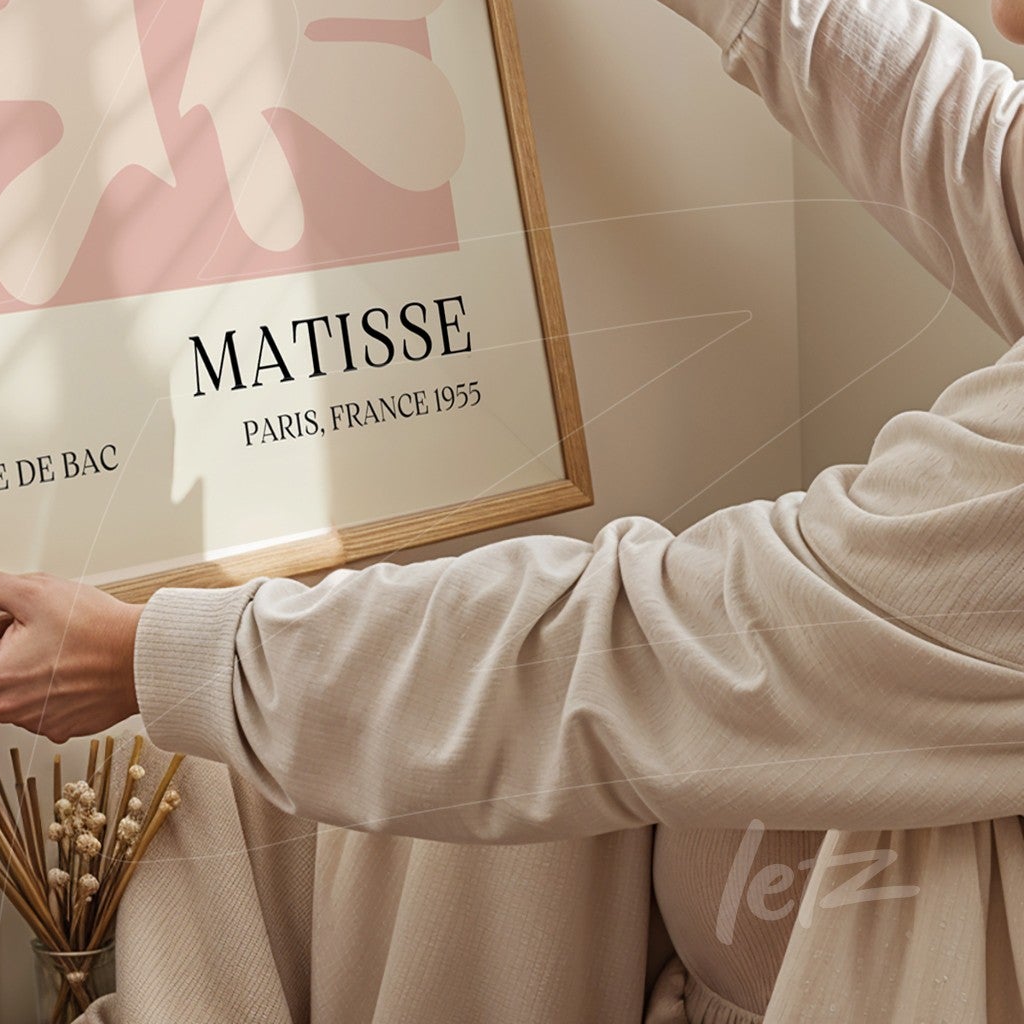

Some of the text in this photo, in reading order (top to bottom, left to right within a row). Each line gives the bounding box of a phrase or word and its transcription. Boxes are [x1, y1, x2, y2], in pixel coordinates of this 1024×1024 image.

[188, 295, 472, 397] MATISSE
[243, 380, 482, 447] PARIS, FRANCE 1955
[15, 454, 55, 488] DE
[61, 444, 120, 479] BAC
